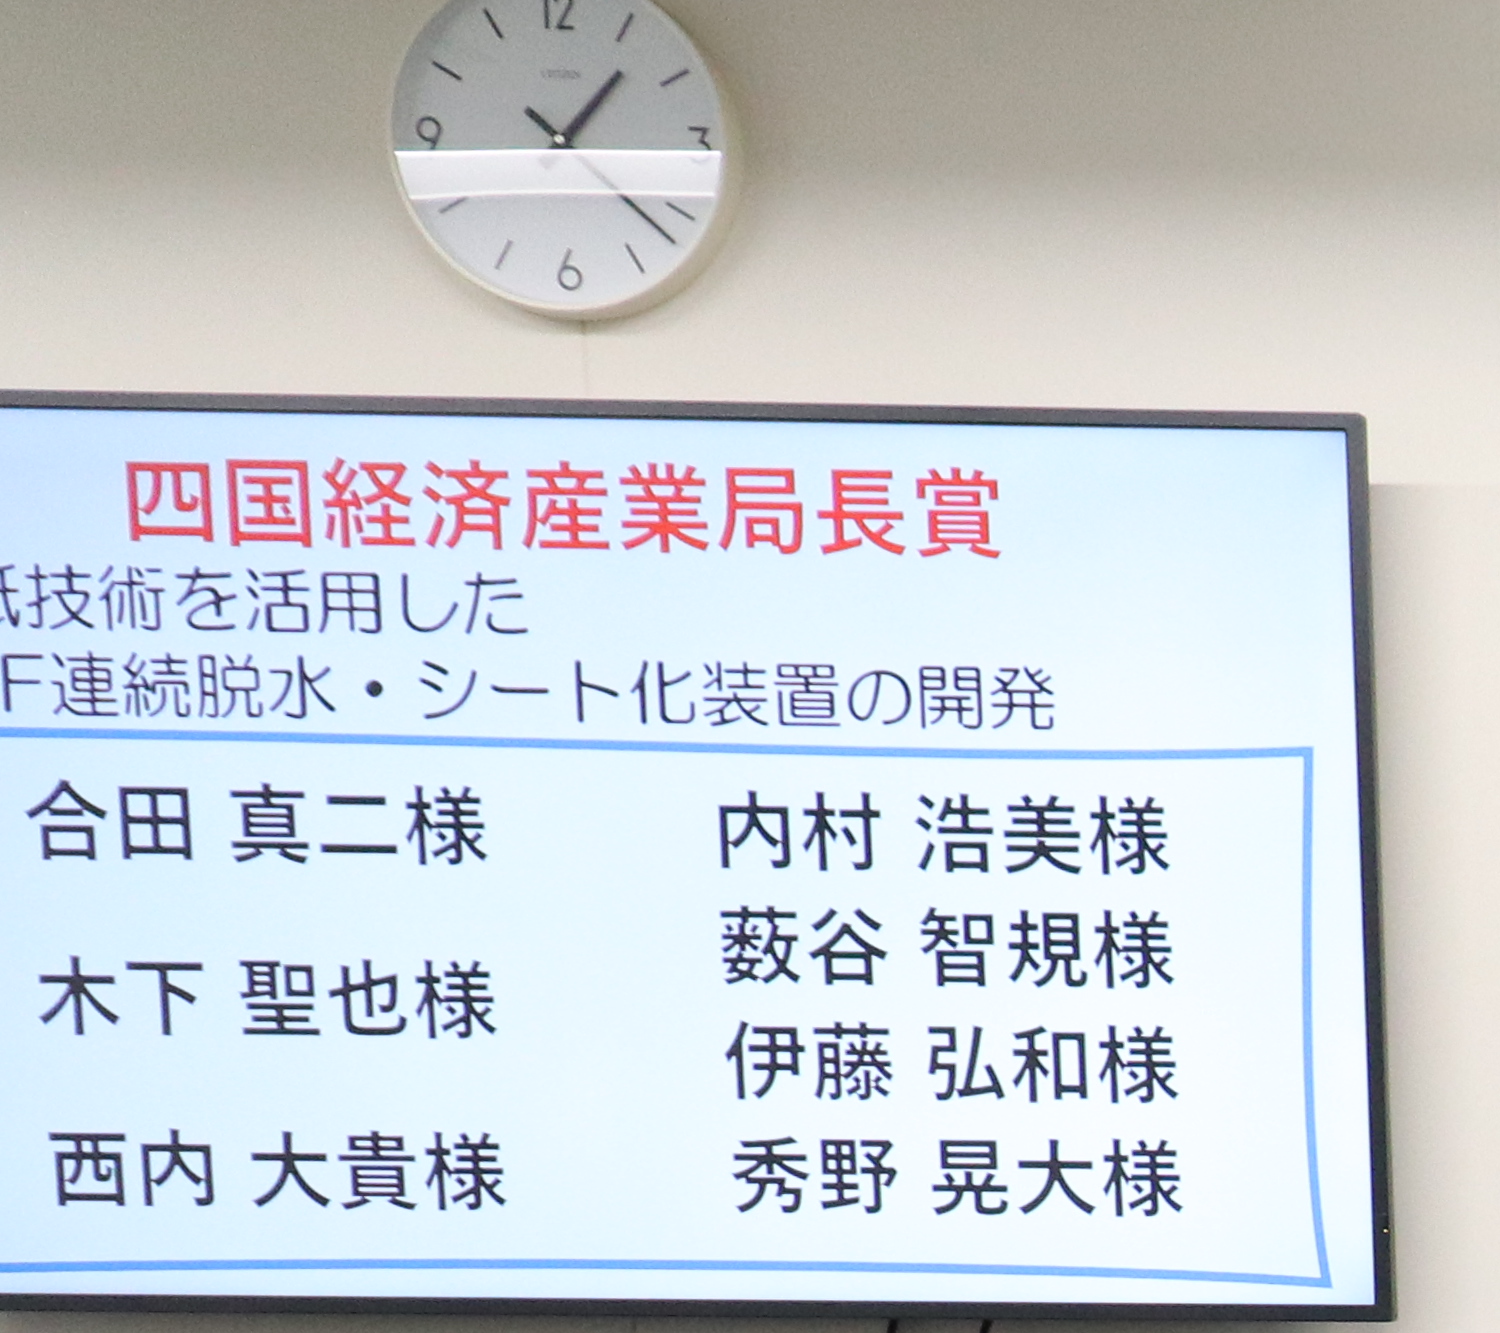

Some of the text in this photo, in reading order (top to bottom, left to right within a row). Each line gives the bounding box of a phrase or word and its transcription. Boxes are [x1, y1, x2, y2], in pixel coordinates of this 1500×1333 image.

[557, 251, 583, 291] 6
[125, 457, 1001, 559] 四国経済産業局長賞
[25, 779, 488, 866] 合田 真二様
[718, 789, 1170, 876] 内村 浩美様
[920, 906, 1175, 990] 智規様
[38, 955, 497, 1040] 木下 聖也様
[724, 1020, 1179, 1104] 伊藤 弘和様
[48, 1128, 507, 1211] 西内 大貴様
[732, 1135, 1183, 1218] 秀野 晃大様
